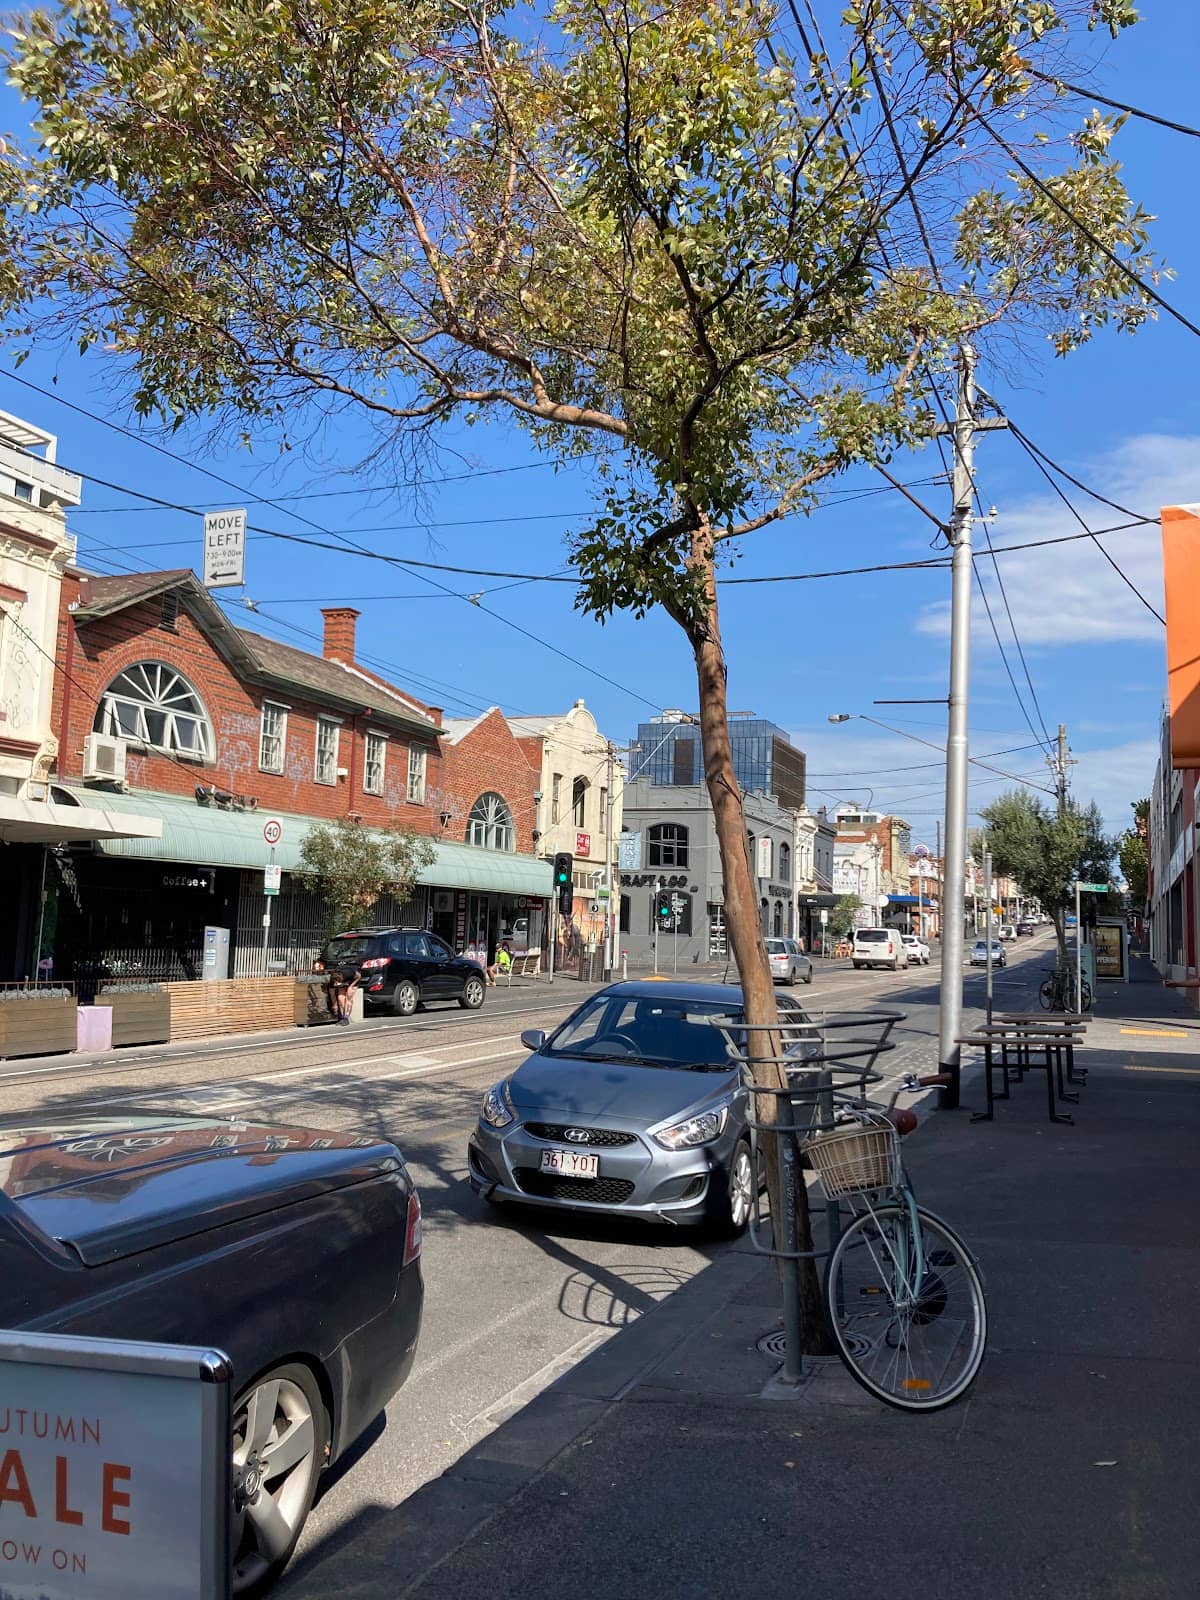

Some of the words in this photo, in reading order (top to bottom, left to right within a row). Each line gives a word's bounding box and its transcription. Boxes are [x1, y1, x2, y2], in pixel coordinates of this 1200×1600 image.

[208, 516, 242, 531] MOVE
[208, 533, 241, 547] LEFT
[266, 827, 279, 837] 40
[620, 874, 656, 888] RAFT
[543, 1152, 564, 1168] 361
[52, 1549, 87, 1575] ON
